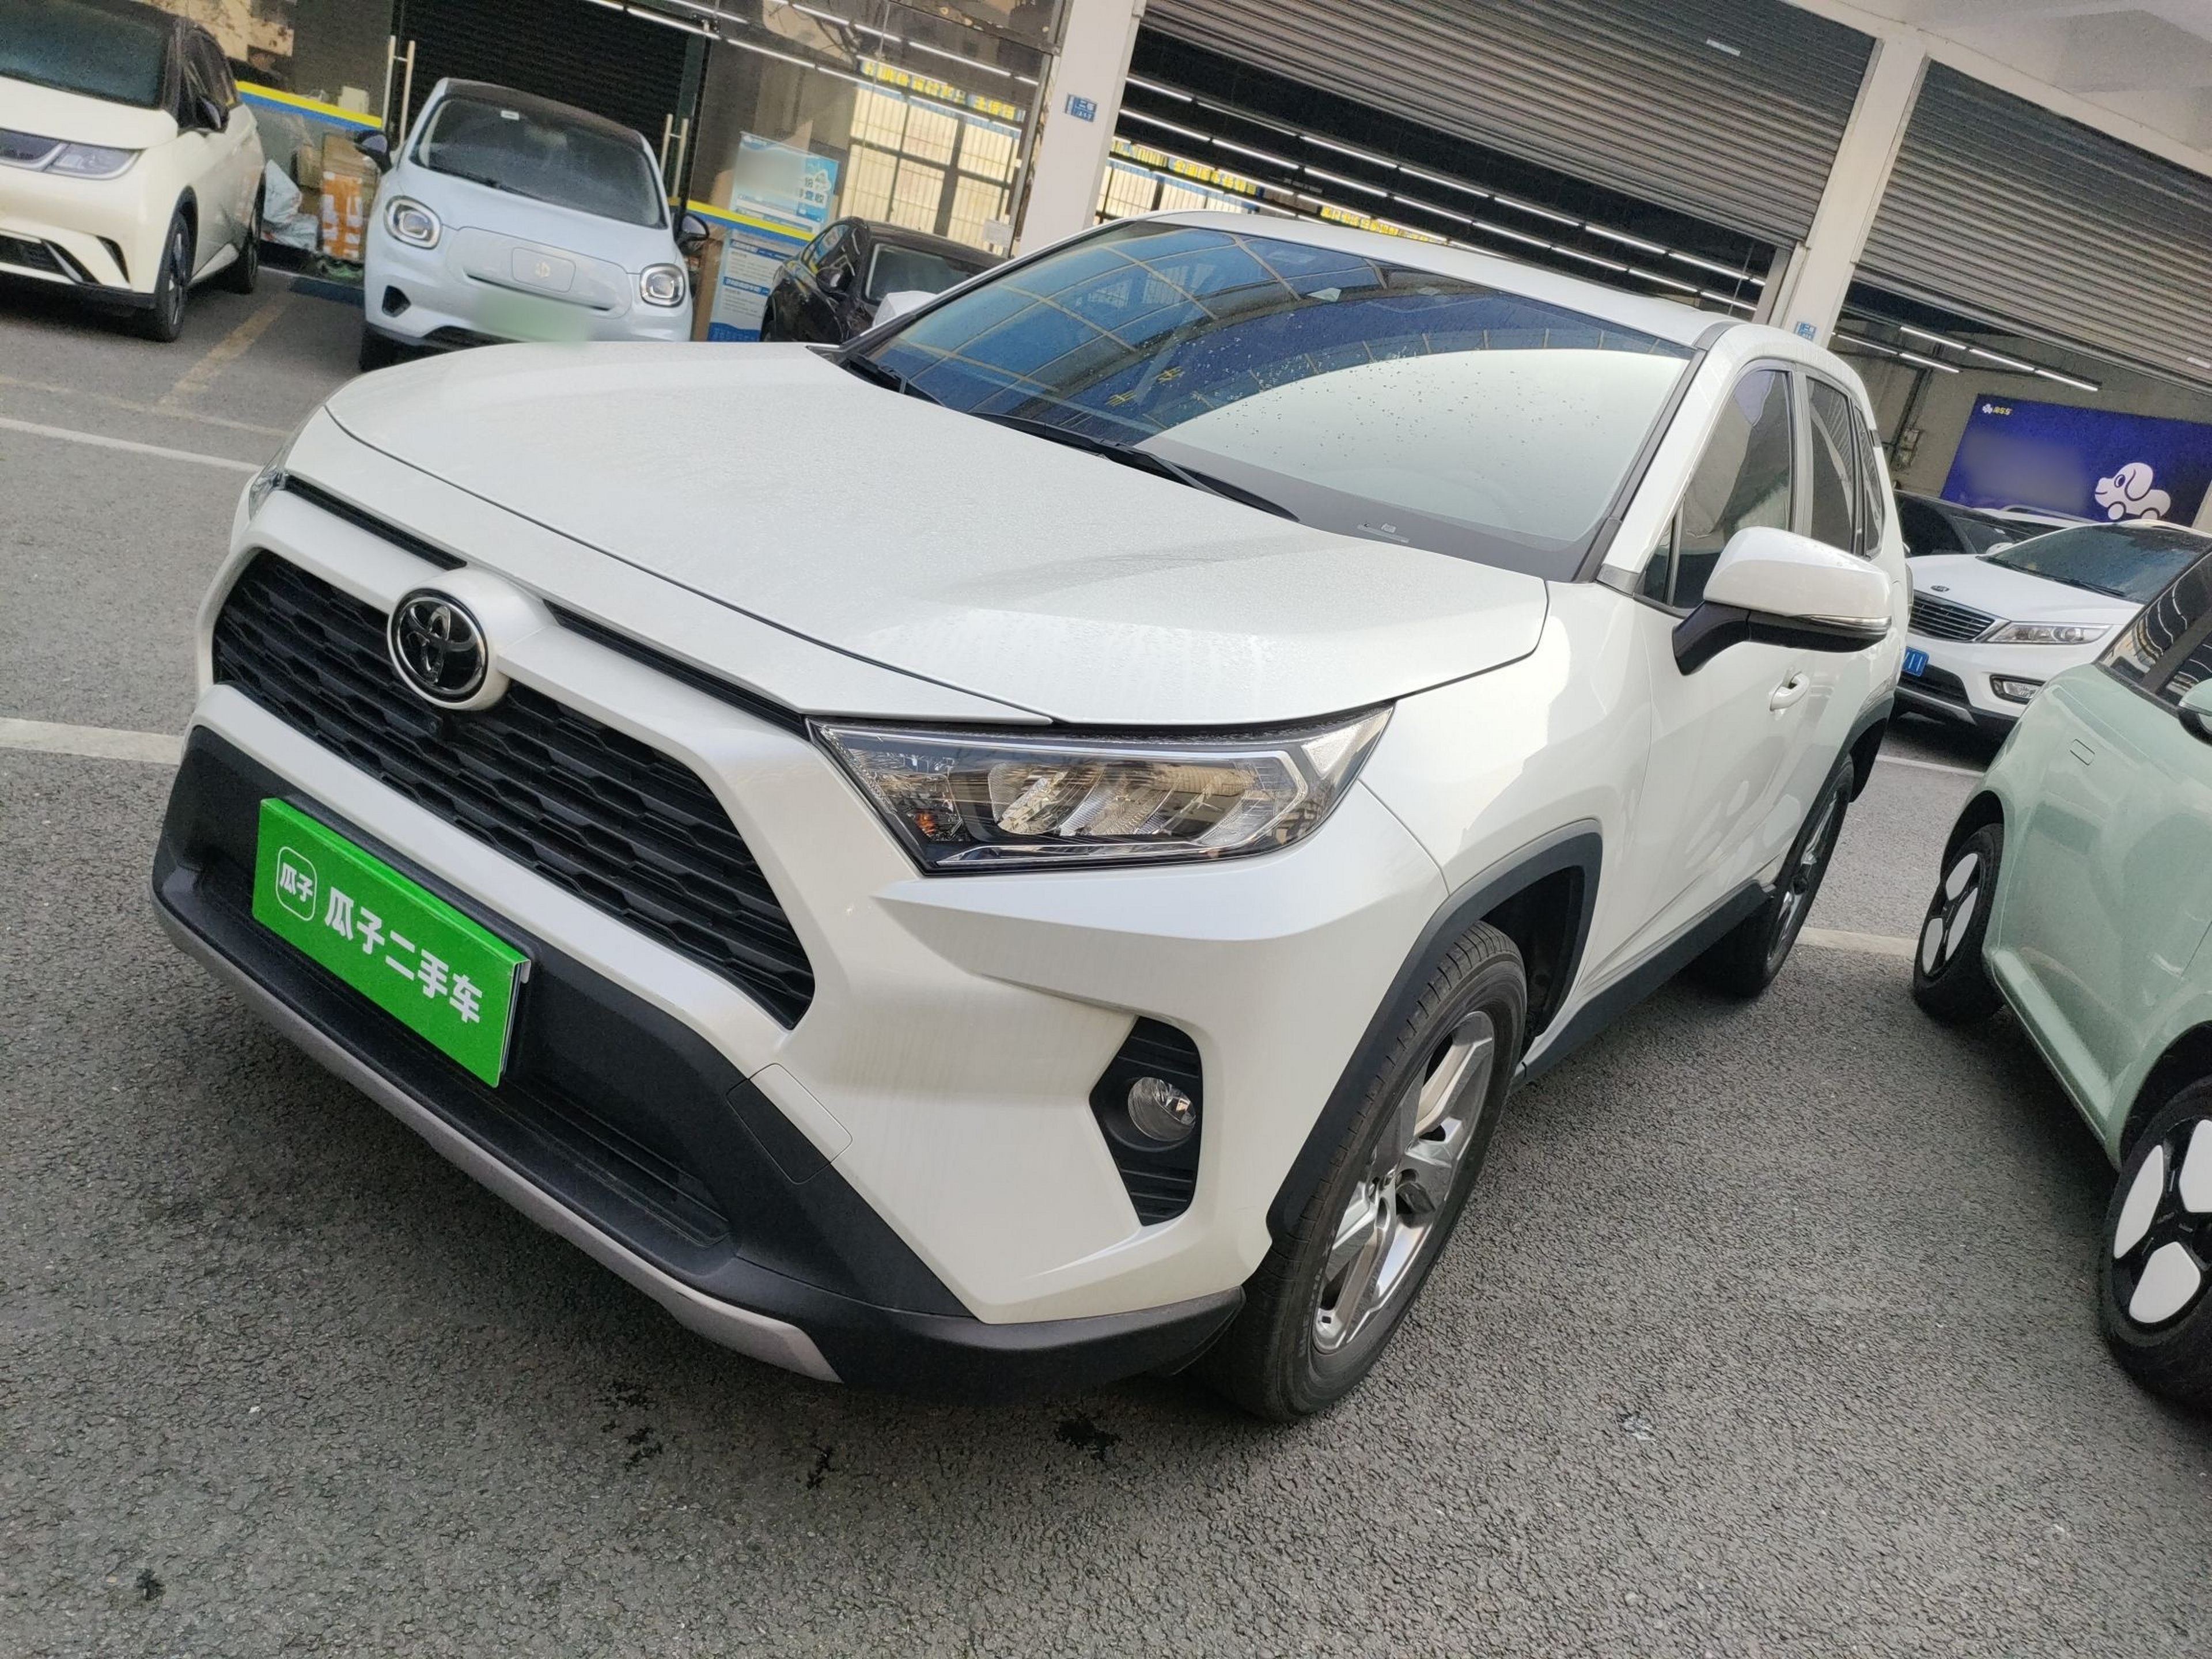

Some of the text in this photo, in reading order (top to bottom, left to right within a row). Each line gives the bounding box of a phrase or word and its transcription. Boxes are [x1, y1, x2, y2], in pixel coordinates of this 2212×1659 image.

[1903, 652, 1923, 672] 11
[279, 862, 314, 903] 瓜子
[324, 886, 483, 1024] 瓜子二手车
